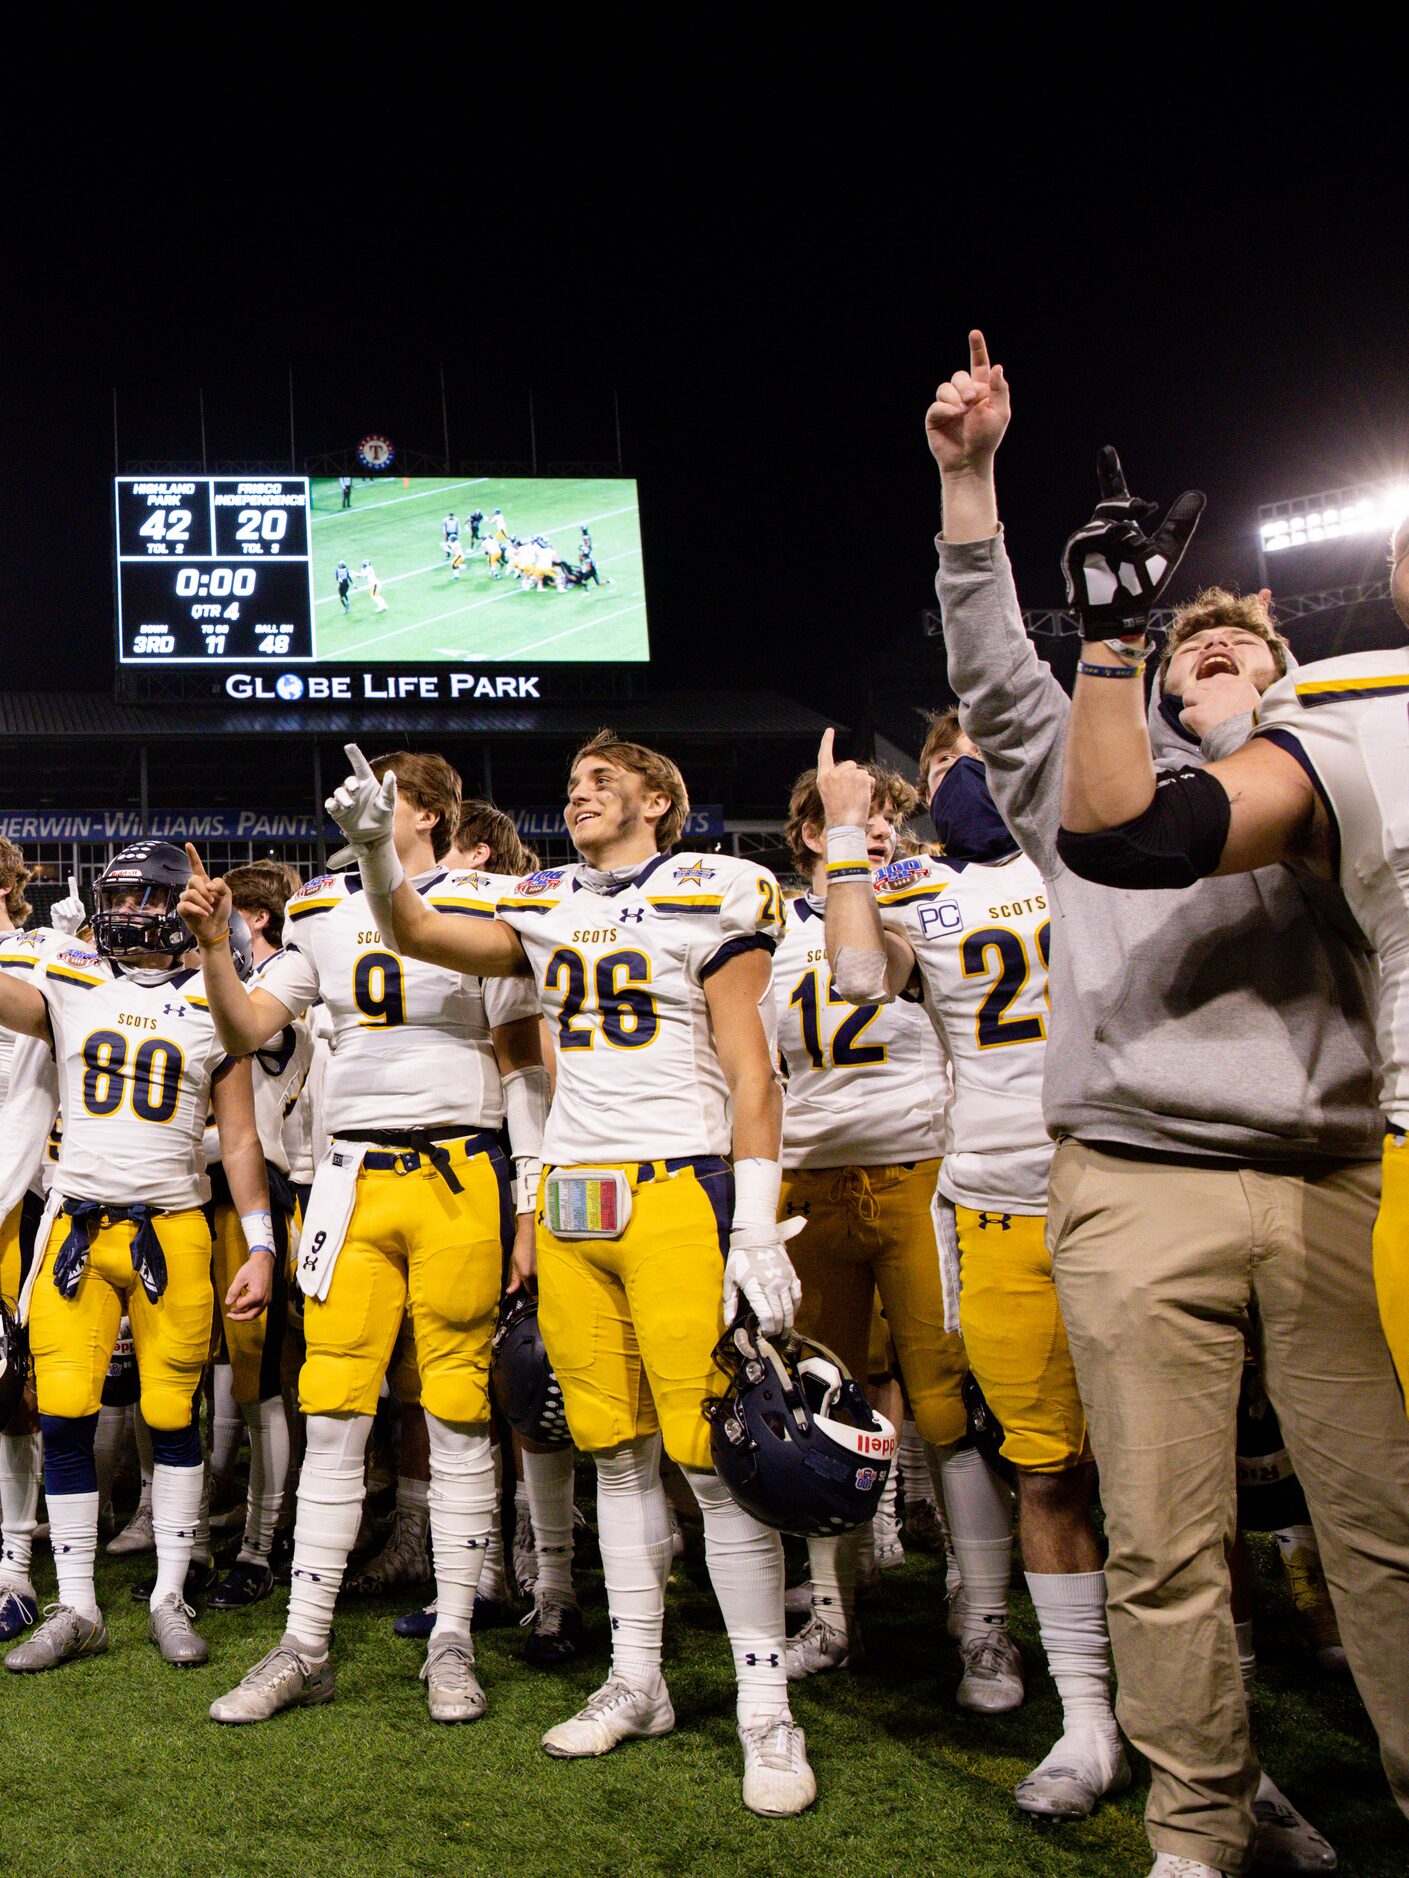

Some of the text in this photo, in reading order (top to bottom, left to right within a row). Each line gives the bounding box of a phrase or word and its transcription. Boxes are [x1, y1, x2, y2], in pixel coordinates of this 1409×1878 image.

[132, 483, 196, 495] HIGHLAND
[237, 483, 283, 495] FRISCO
[146, 495, 182, 506] PARK
[214, 495, 306, 506] INDEPENDENCE
[139, 509, 192, 541] 42
[235, 509, 288, 541] 20
[146, 543, 169, 555] TOL
[241, 543, 264, 555] TOL
[175, 568, 257, 597] 0:00
[191, 601, 240, 621] QTR 4
[133, 635, 175, 653] 3RD
[205, 635, 226, 654] 11
[258, 635, 290, 654] 48
[225, 673, 541, 700] GLOBE LIFE PARK
[989, 896, 1047, 919] SCOTS
[920, 904, 961, 934] PC
[357, 930, 381, 945] SCO
[572, 928, 618, 943] SCOTS
[352, 949, 407, 1031] 9
[959, 918, 1051, 1051] 2
[544, 946, 660, 1051] 26
[117, 1013, 158, 1030] SCOTS
[789, 967, 888, 1070] 12
[82, 1028, 185, 1124] 80
[312, 1230, 327, 1254] 9
[858, 1434, 895, 1456] ddell
